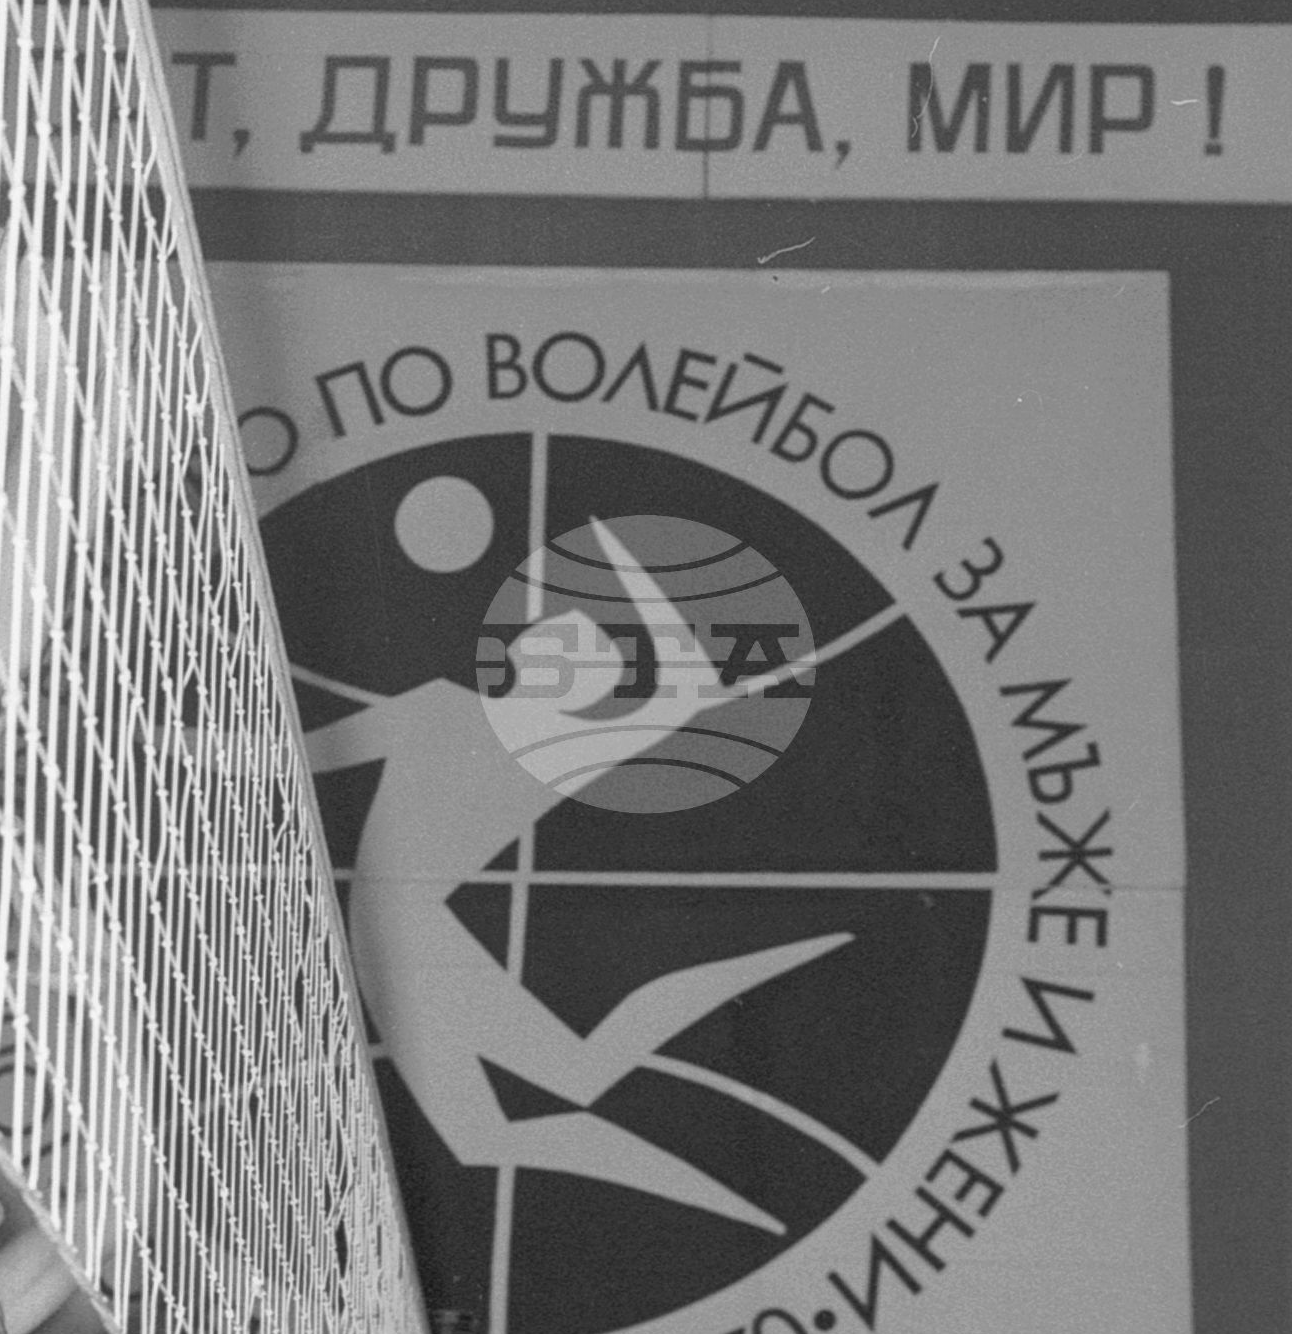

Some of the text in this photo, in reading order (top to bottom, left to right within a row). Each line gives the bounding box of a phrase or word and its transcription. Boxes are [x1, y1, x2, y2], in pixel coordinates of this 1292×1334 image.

[300, 55, 853, 165] ДРУЖБА,
[314, 346, 453, 438] ПО
[483, 331, 940, 551] ВОЛЕЙБОЛ
[931, 537, 1037, 663] ЗА
[999, 679, 1112, 947] МЪЖЕ
[1000, 976, 1095, 1054] И
[827, 1061, 1059, 1331] ЖЕНИ
